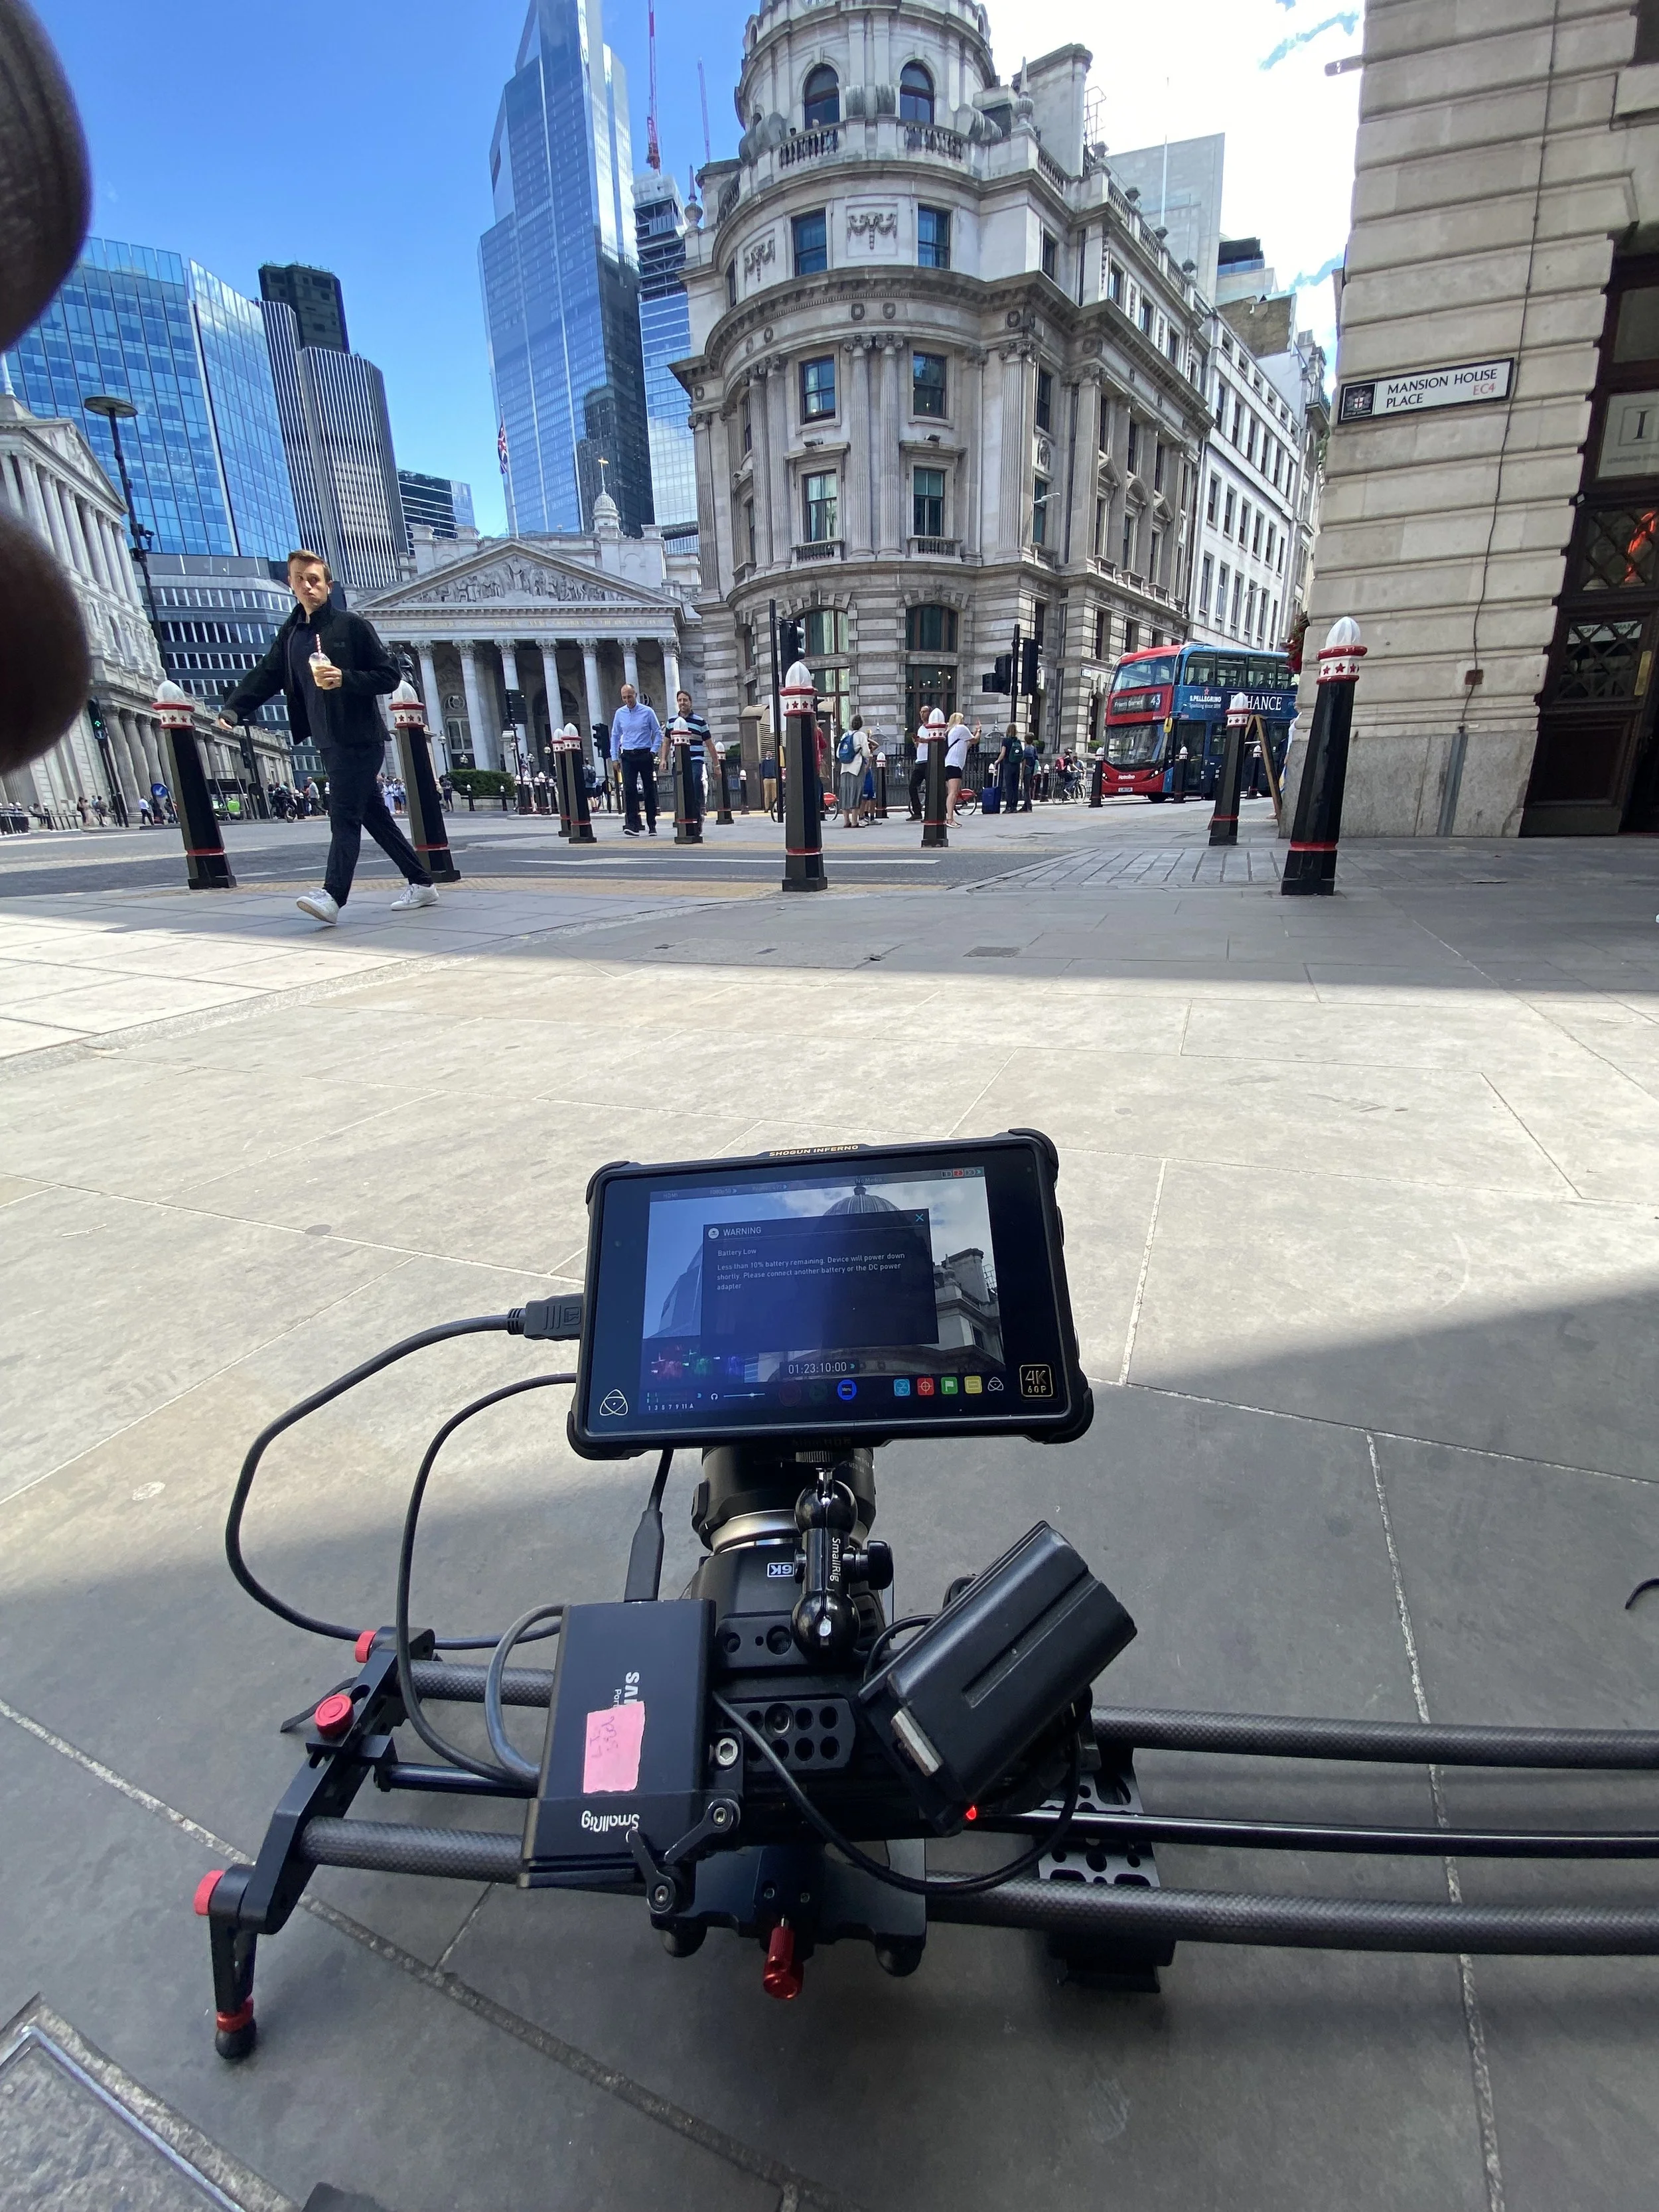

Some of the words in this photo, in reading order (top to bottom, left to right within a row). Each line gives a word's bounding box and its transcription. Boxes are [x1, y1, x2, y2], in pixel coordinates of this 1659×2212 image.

[1388, 376, 1449, 395] MANSION
[1454, 368, 1498, 384] HOUSE
[1473, 383, 1496, 396] EC4
[1386, 393, 1423, 408] PLACE
[1150, 694, 1161, 705] 43
[813, 1145, 859, 1153] INFERNO
[723, 1226, 762, 1236] WARNING
[788, 1362, 847, 1374] 01:23:10:00
[1025, 1370, 1046, 1384] 4K
[1027, 1385, 1047, 1394] 60P
[830, 1536, 841, 1583] SmallRig
[770, 1564, 792, 1575] 6K
[581, 1809, 640, 1833] SmallRig
